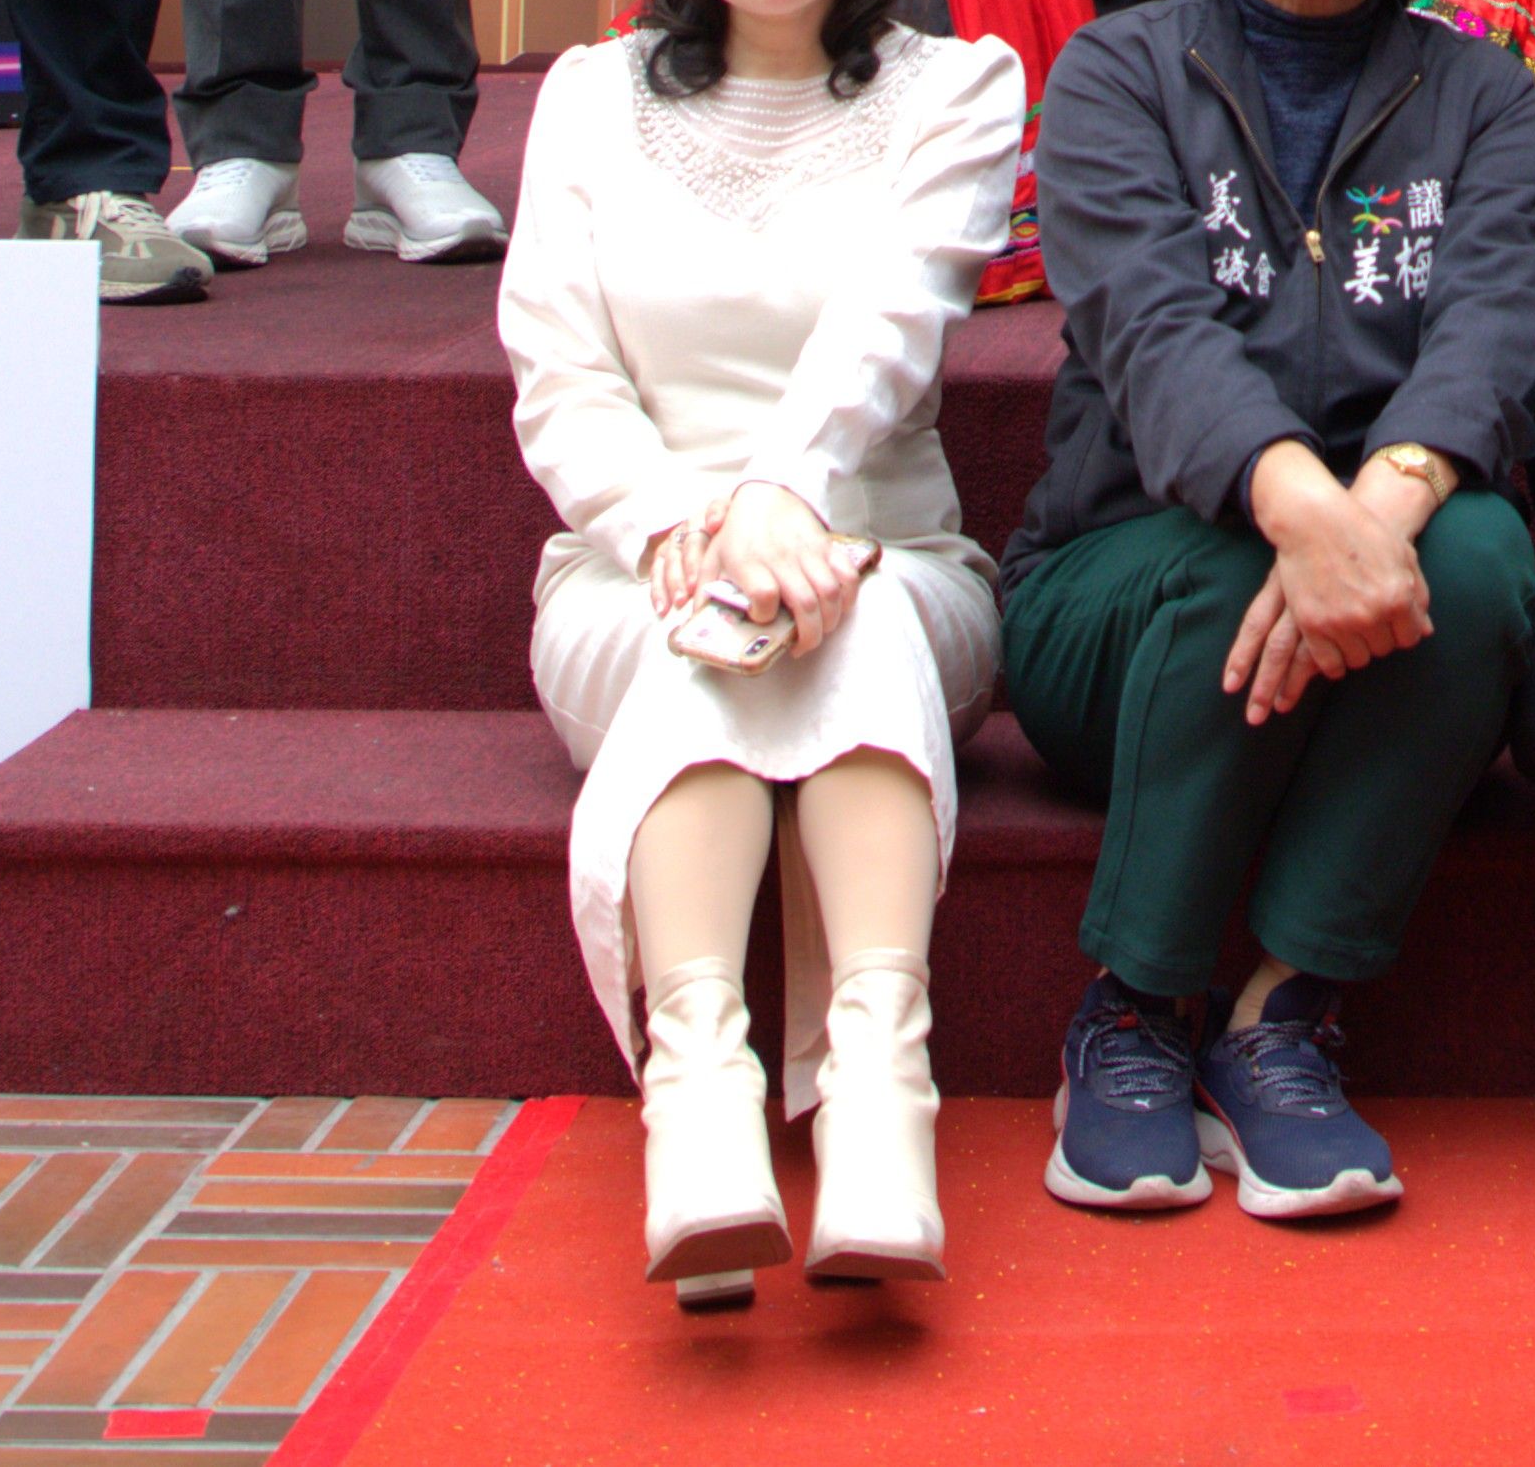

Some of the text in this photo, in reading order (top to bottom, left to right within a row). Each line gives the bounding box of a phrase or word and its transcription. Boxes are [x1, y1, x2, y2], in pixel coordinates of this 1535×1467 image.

[1407, 178, 1445, 230] 議
[1214, 246, 1277, 297] 議會
[1343, 235, 1434, 305] 姜梅
